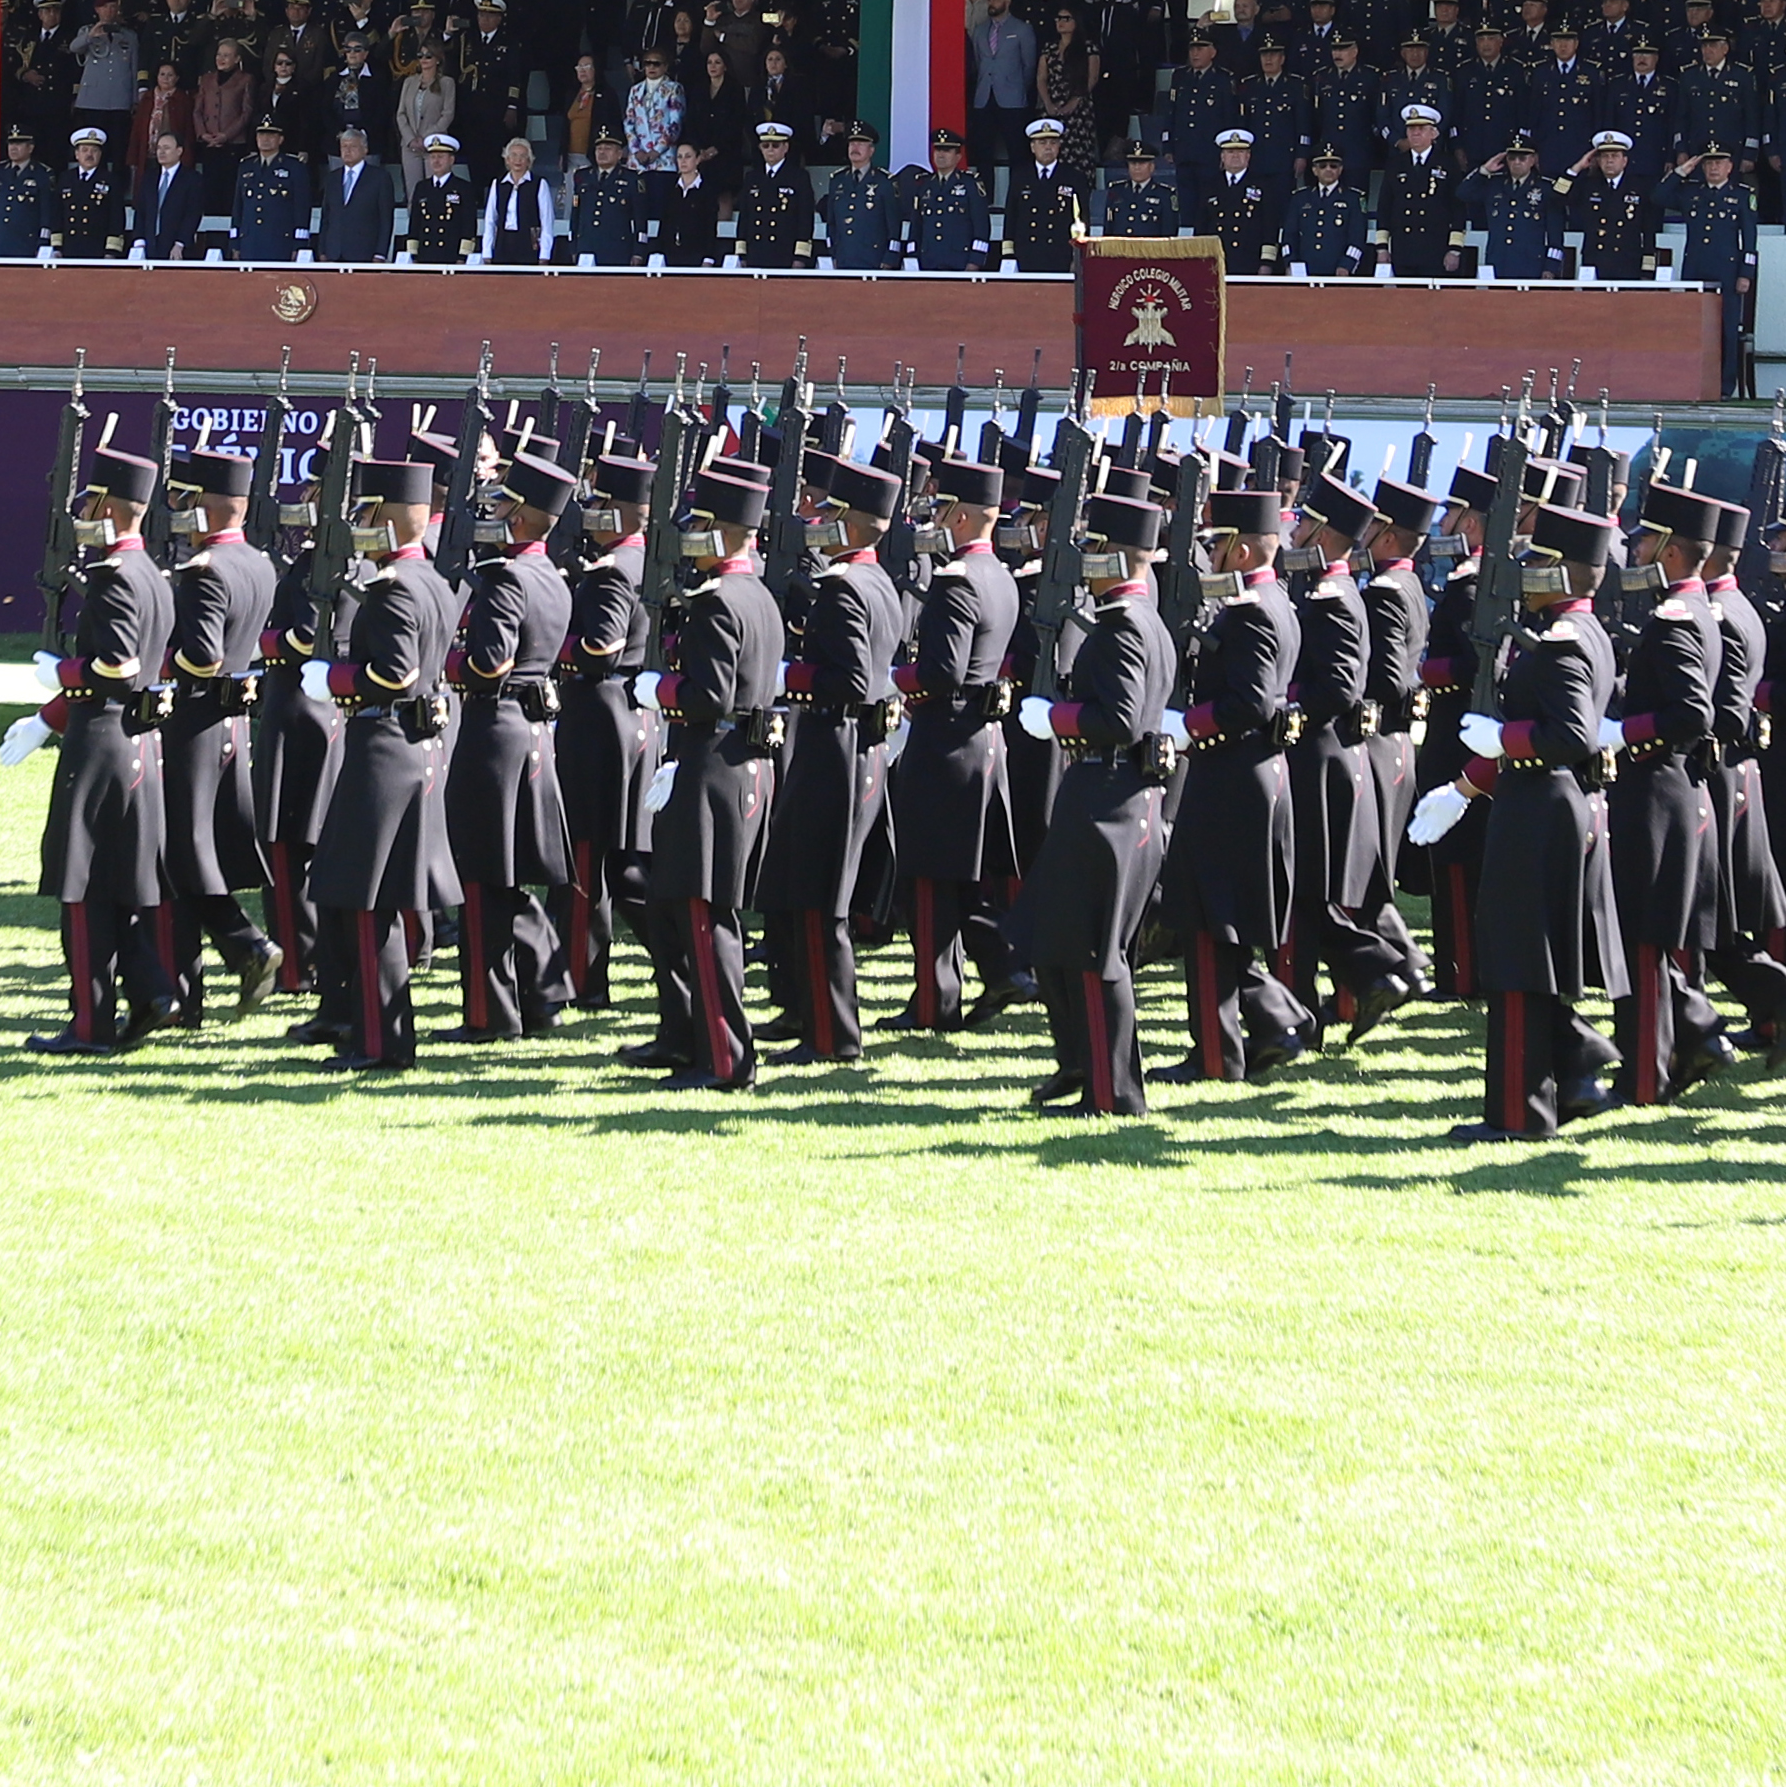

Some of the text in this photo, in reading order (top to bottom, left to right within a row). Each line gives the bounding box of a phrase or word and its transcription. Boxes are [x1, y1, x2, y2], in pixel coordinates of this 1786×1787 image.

[1108, 267, 1193, 312] HEROICO COLEGIO MILITAR
[172, 407, 318, 435] GOBIENO
